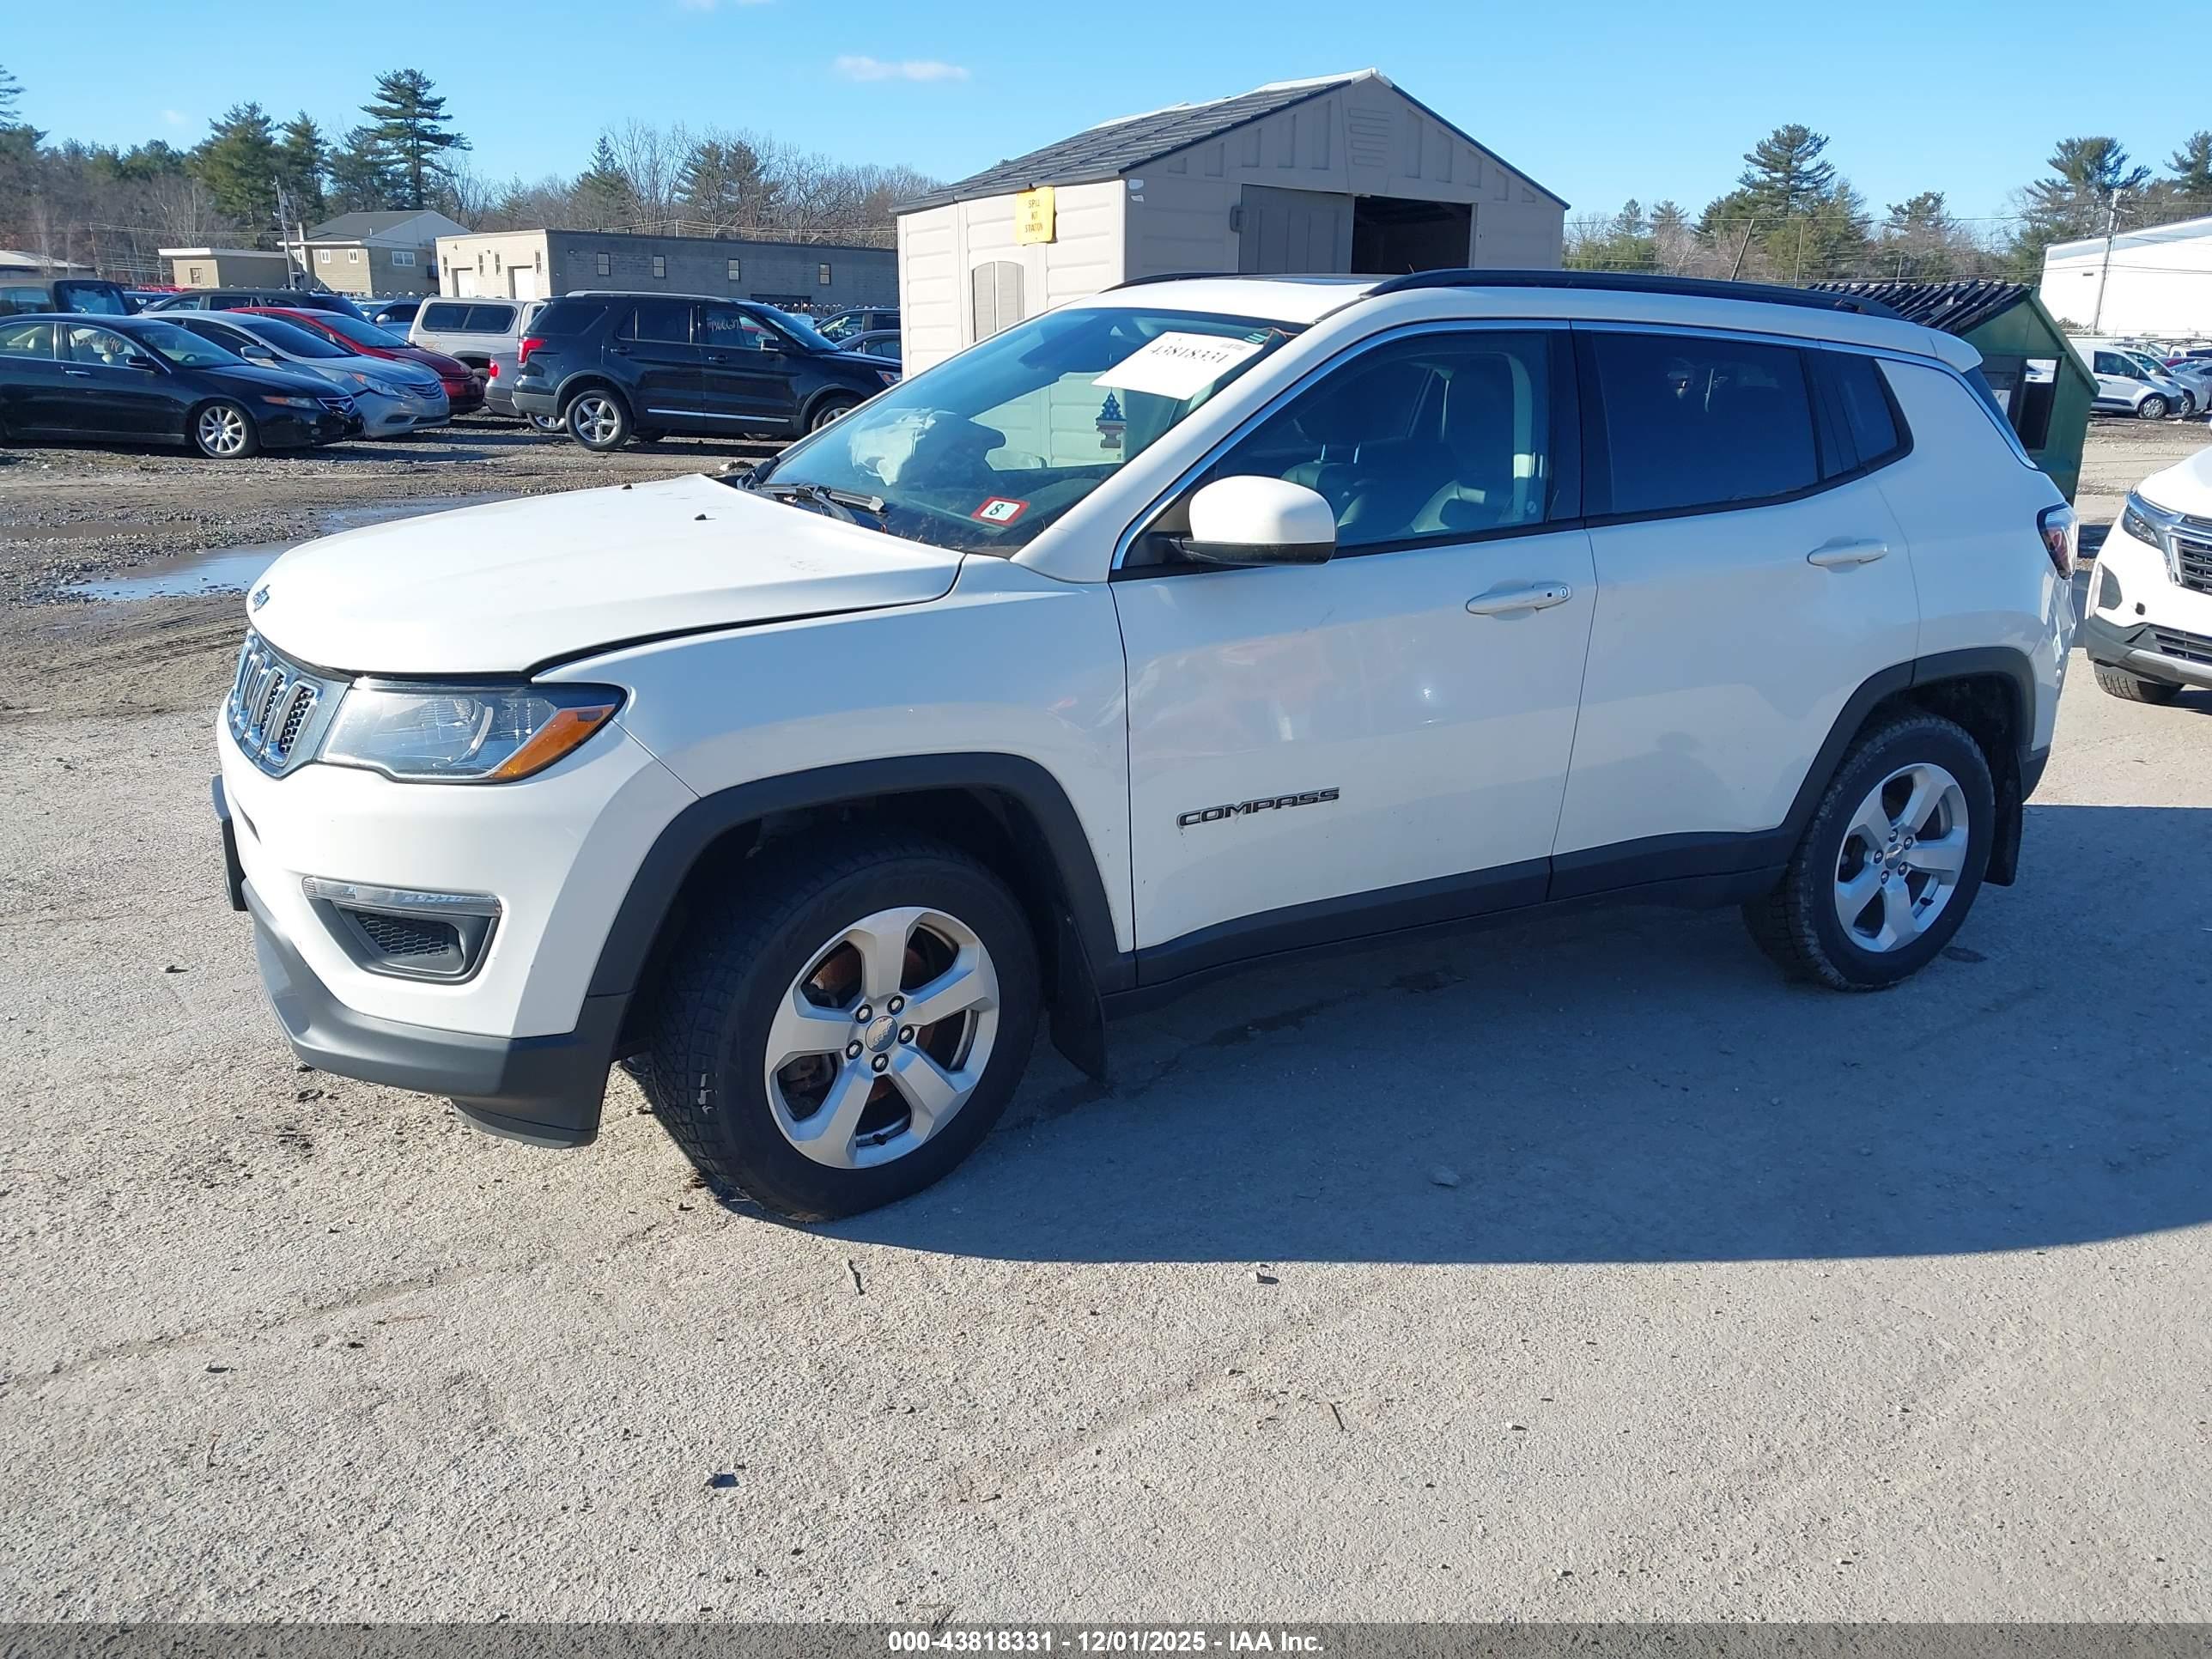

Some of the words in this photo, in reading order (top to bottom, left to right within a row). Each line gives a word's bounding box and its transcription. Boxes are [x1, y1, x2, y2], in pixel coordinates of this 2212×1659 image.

[1028, 198, 1041, 209] SPILL
[1024, 222, 1043, 233] STATION
[989, 503, 1005, 515] 8
[1176, 786, 1340, 828] COMPASS
